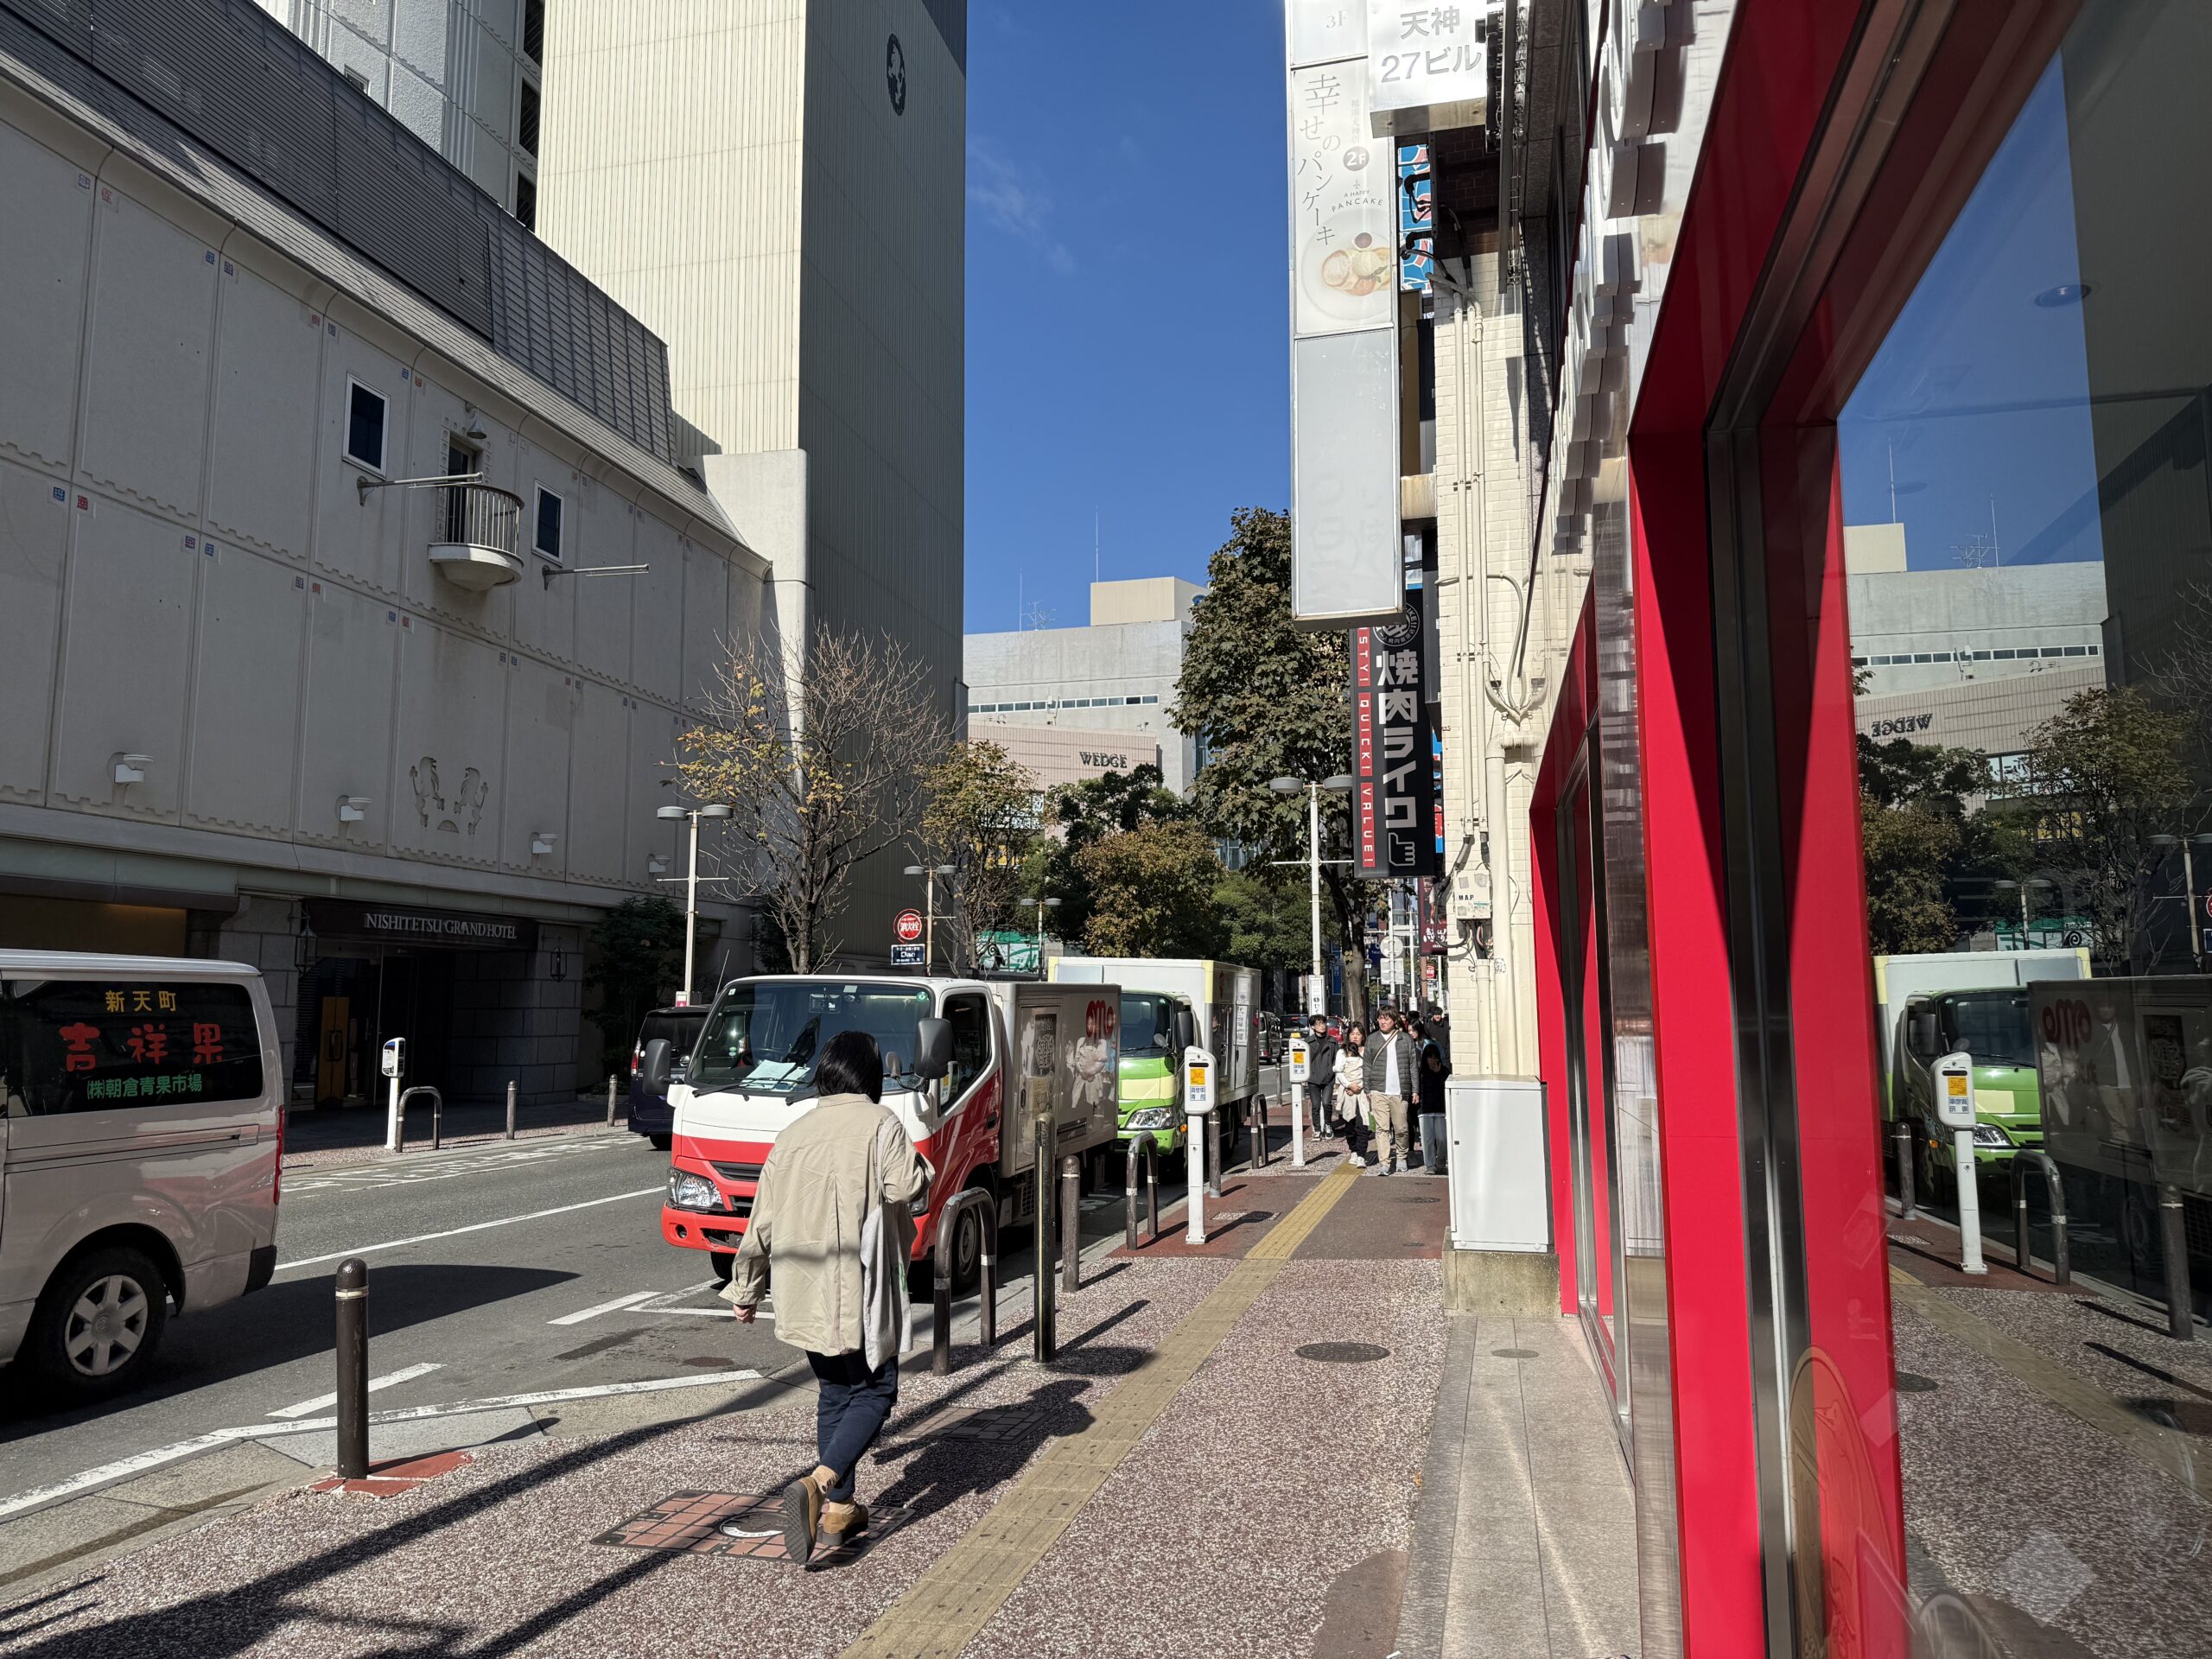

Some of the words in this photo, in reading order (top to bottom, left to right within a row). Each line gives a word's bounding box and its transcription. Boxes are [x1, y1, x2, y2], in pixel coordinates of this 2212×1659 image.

[1400, 6, 1461, 40] 天神
[1381, 44, 1482, 84] 27ビル
[1297, 73, 1341, 246] 幸せのパンケーキ
[1346, 151, 1366, 167] 2F
[1332, 197, 1383, 213] PANCAKE
[1376, 649, 1418, 829] 焼肉ライク
[1079, 751, 1128, 769] WEDGE
[365, 912, 443, 933] NISHITETSU
[444, 919, 486, 936] GRAND
[486, 925, 517, 939] HOTEL
[105, 990, 176, 1014] 新天町
[59, 1022, 224, 1072] 吉祥果
